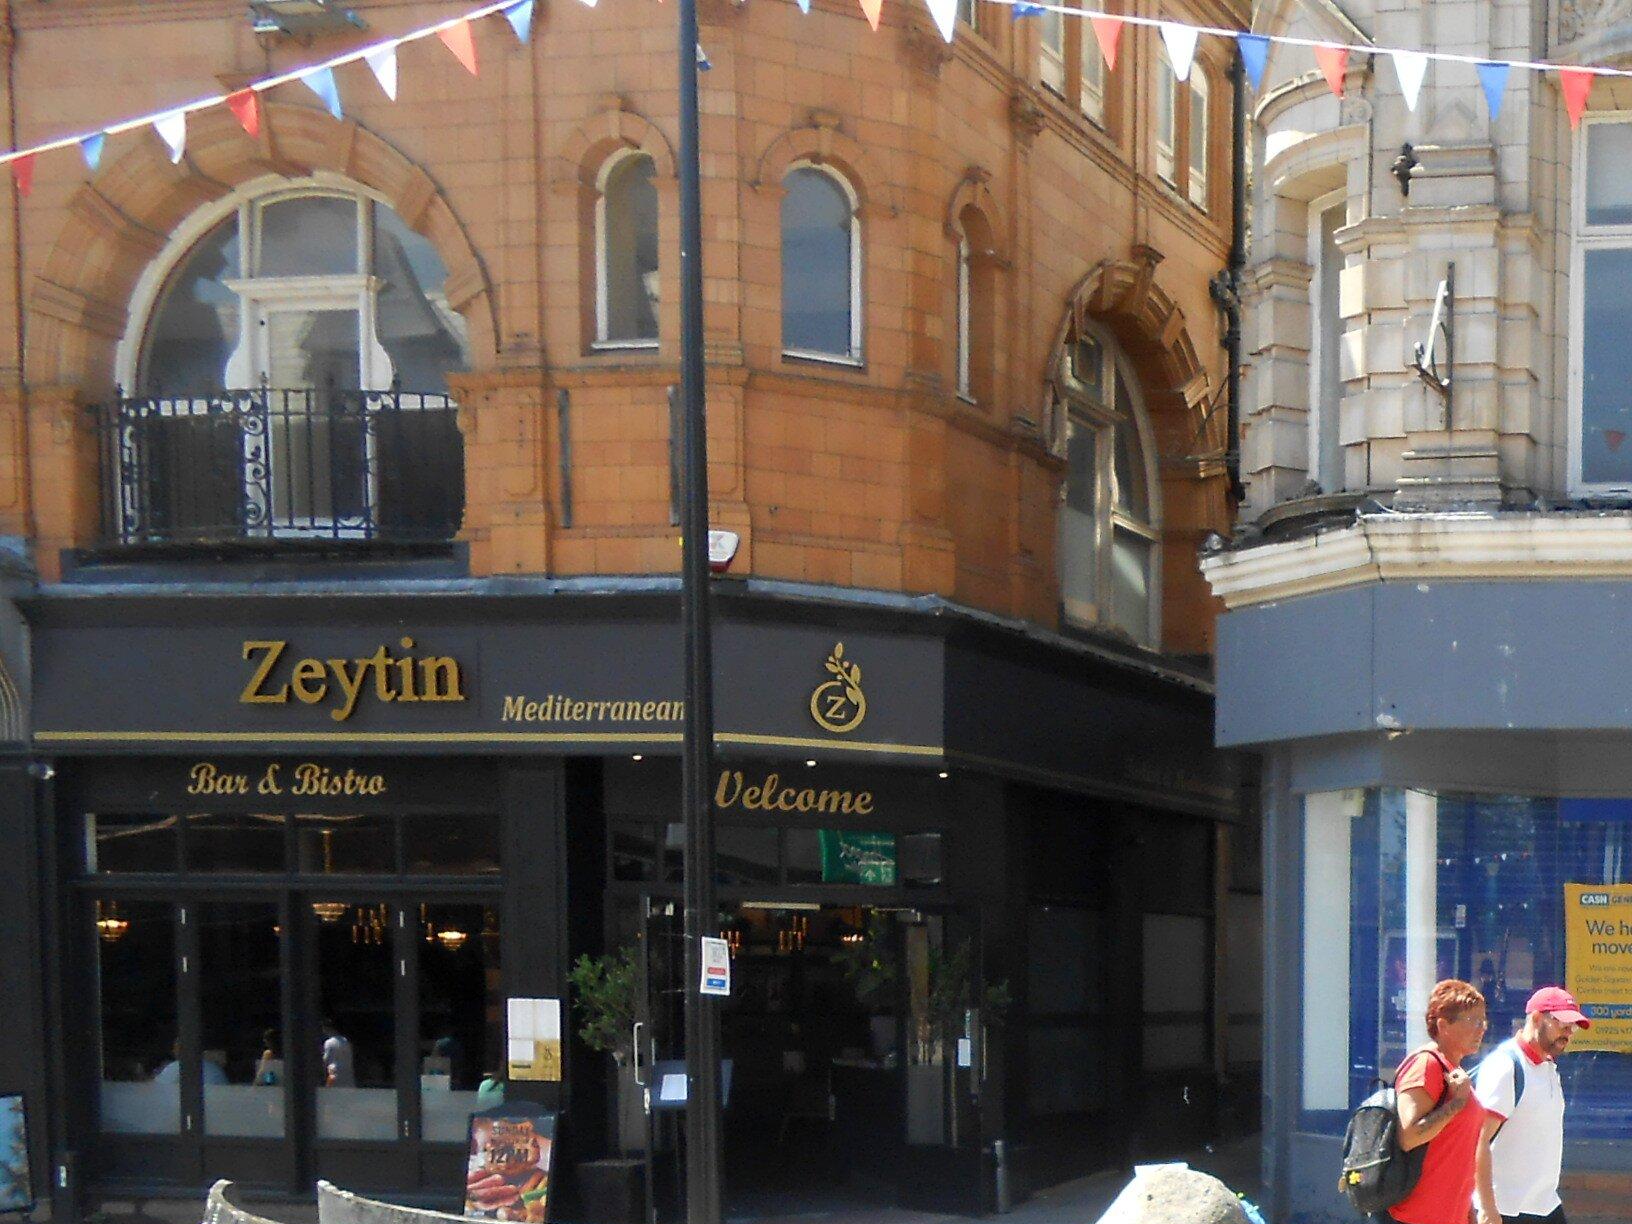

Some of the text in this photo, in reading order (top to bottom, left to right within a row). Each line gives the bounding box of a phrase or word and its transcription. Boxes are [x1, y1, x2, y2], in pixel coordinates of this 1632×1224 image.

[239, 636, 466, 722] Zeytin
[502, 694, 685, 722] Mediterranean
[187, 762, 386, 795] Bar & Bistro
[1581, 894, 1608, 904] CASH
[1585, 919, 1615, 936] We
[1591, 1006, 1609, 1016] 300
